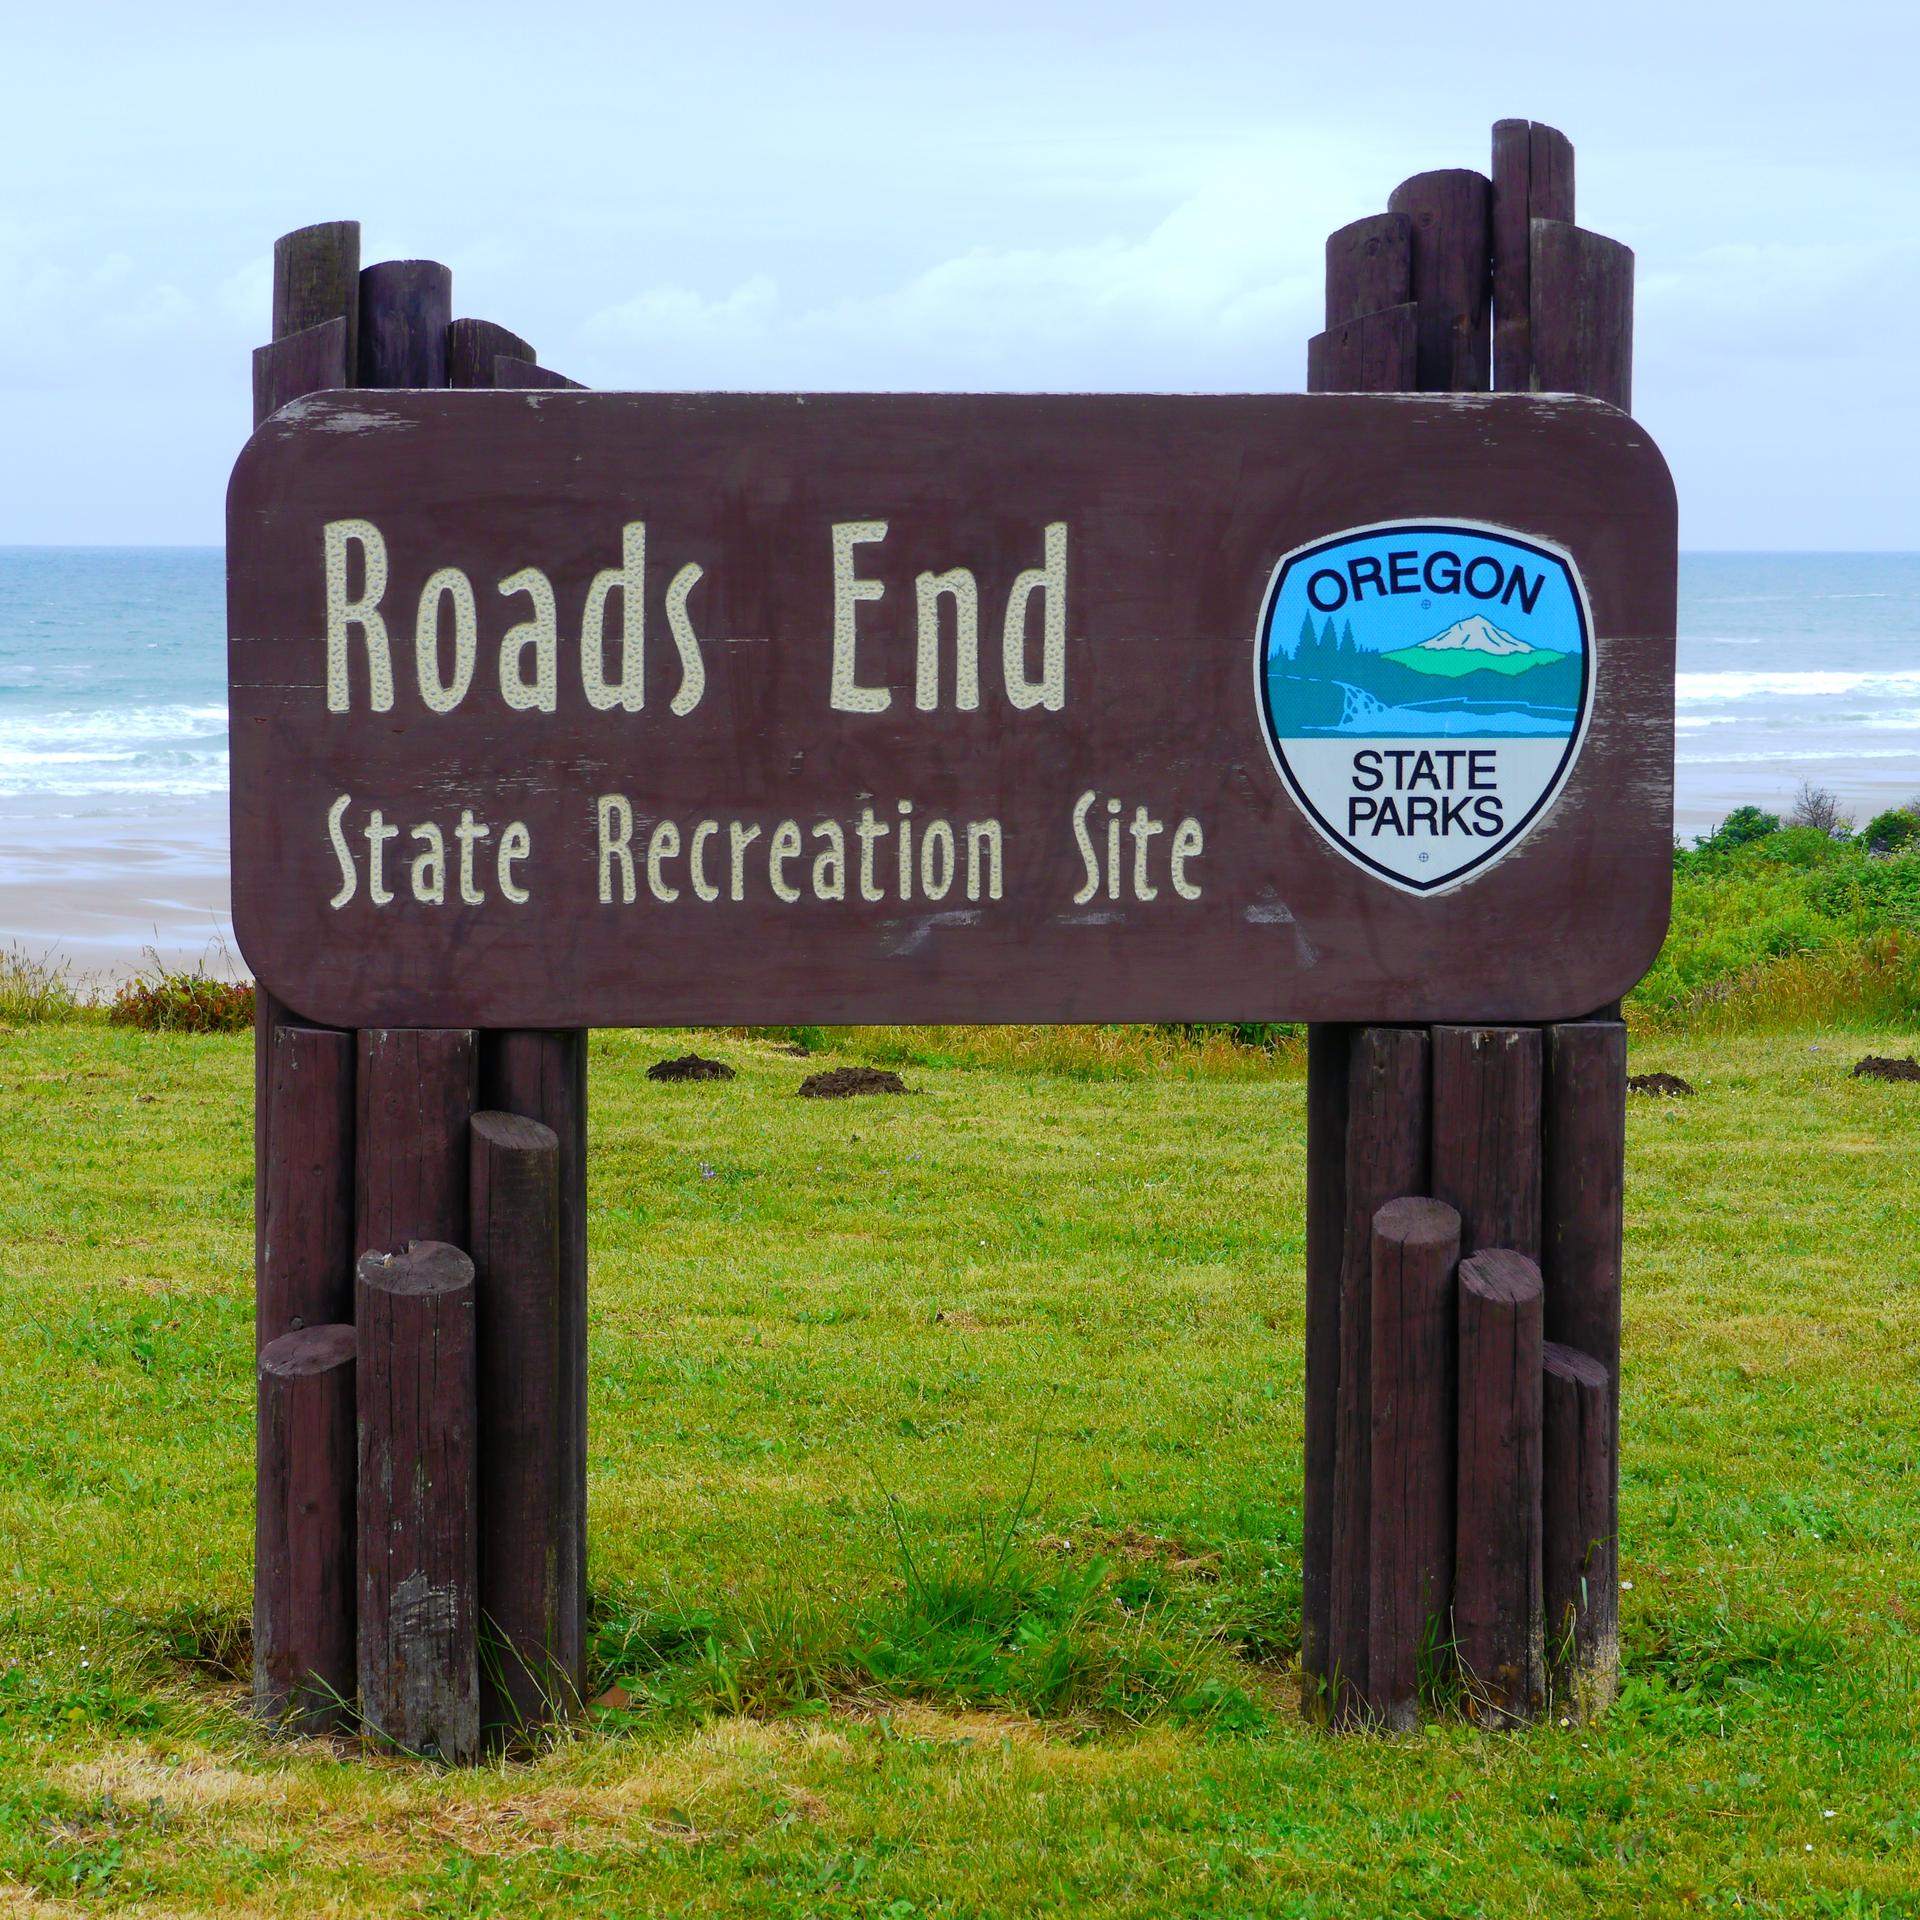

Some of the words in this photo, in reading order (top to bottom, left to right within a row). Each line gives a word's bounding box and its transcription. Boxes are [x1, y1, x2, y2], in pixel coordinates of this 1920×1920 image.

[1306, 550, 1546, 615] OREGON
[322, 517, 707, 718] Roads
[829, 519, 1069, 714] End
[1352, 749, 1498, 792] STATE
[1348, 795, 1505, 838] PARKS
[327, 793, 532, 911] State
[596, 793, 1004, 906] Recreation
[1071, 789, 1205, 906] Site
